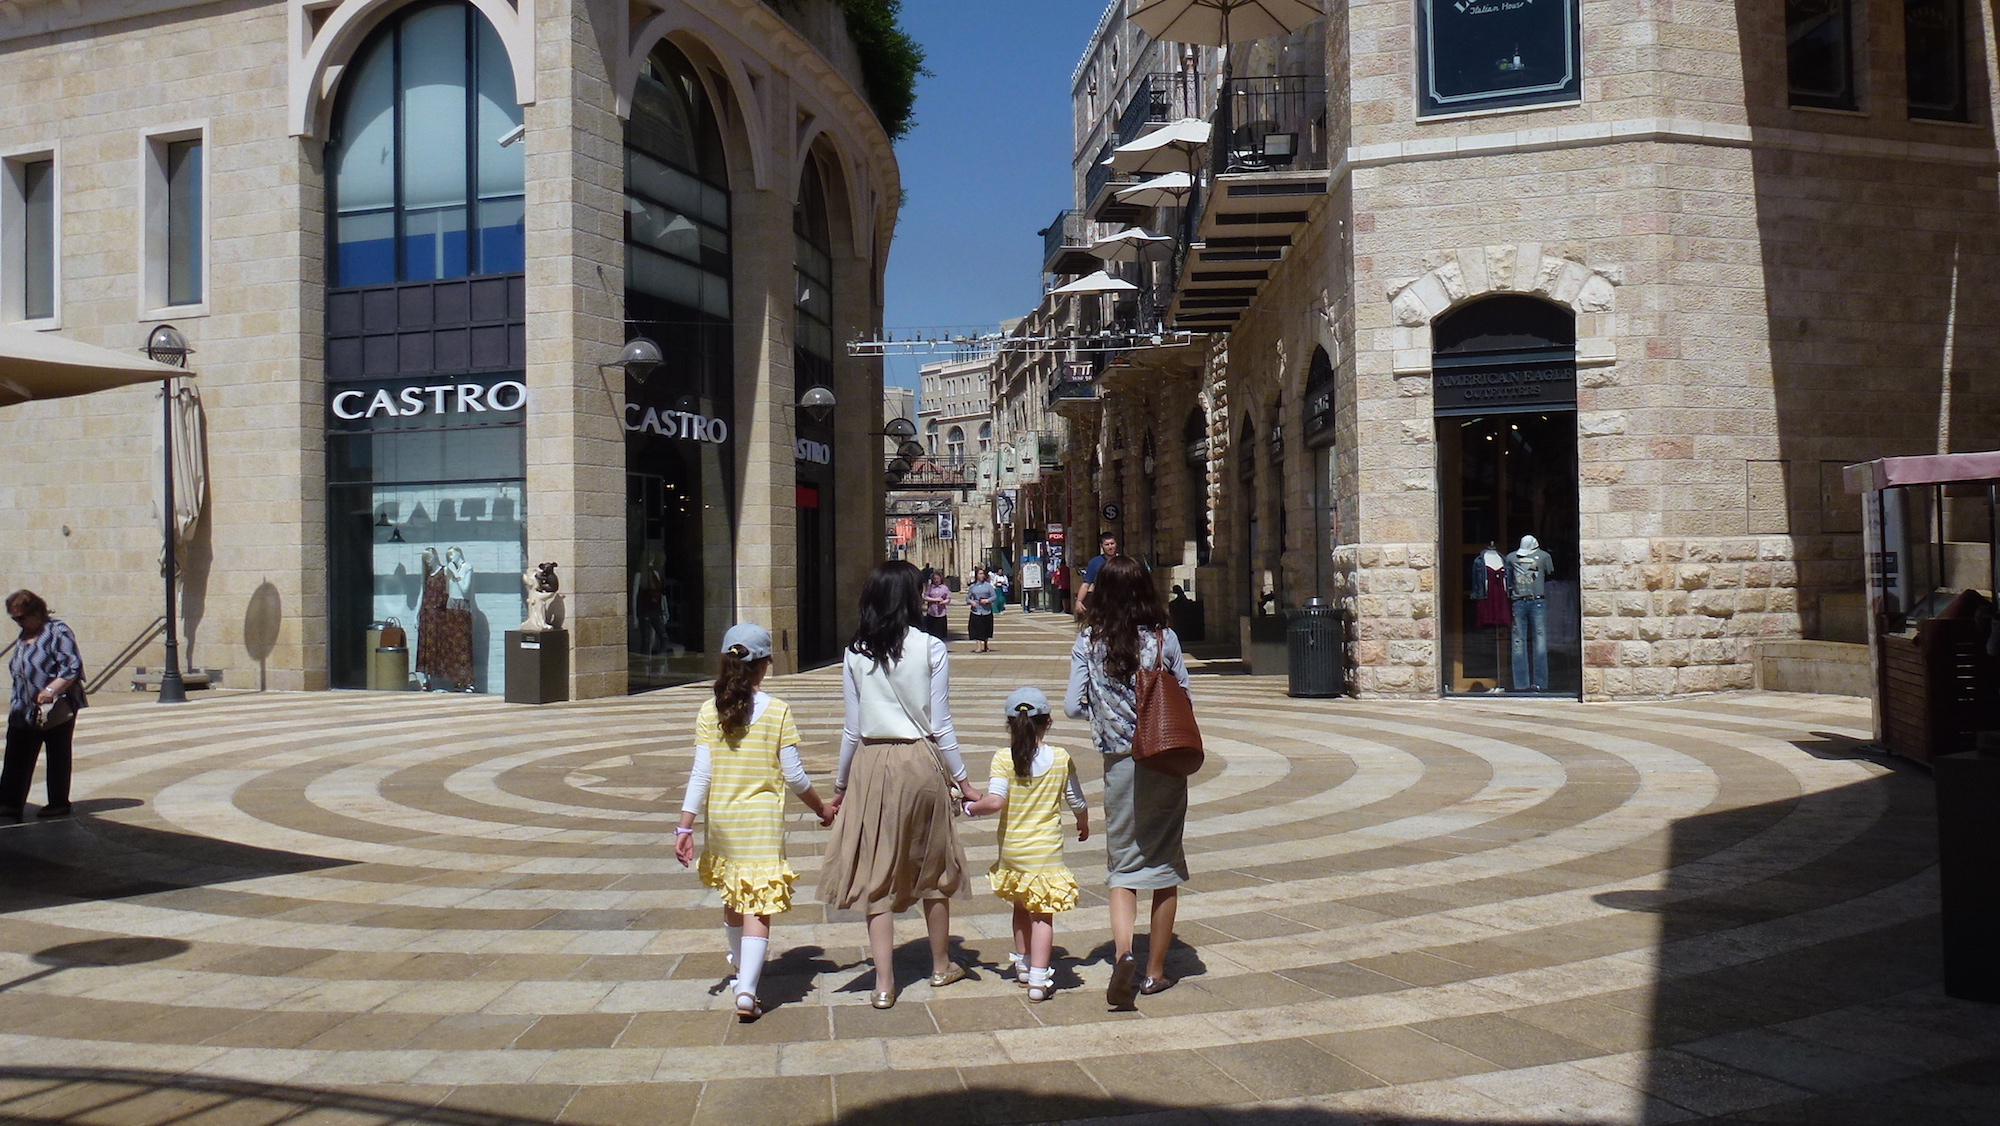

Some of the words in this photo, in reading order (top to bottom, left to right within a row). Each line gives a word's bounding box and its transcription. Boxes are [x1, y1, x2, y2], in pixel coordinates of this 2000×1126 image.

[1469, 4, 1500, 14] Italian
[1501, 2, 1524, 10] House
[1437, 370, 1519, 387] AMERICAN
[1523, 368, 1573, 383] EAGLE
[332, 381, 527, 419] CASTRO
[1464, 385, 1541, 399] OUTFITTERS
[625, 403, 728, 444] CASTRO
